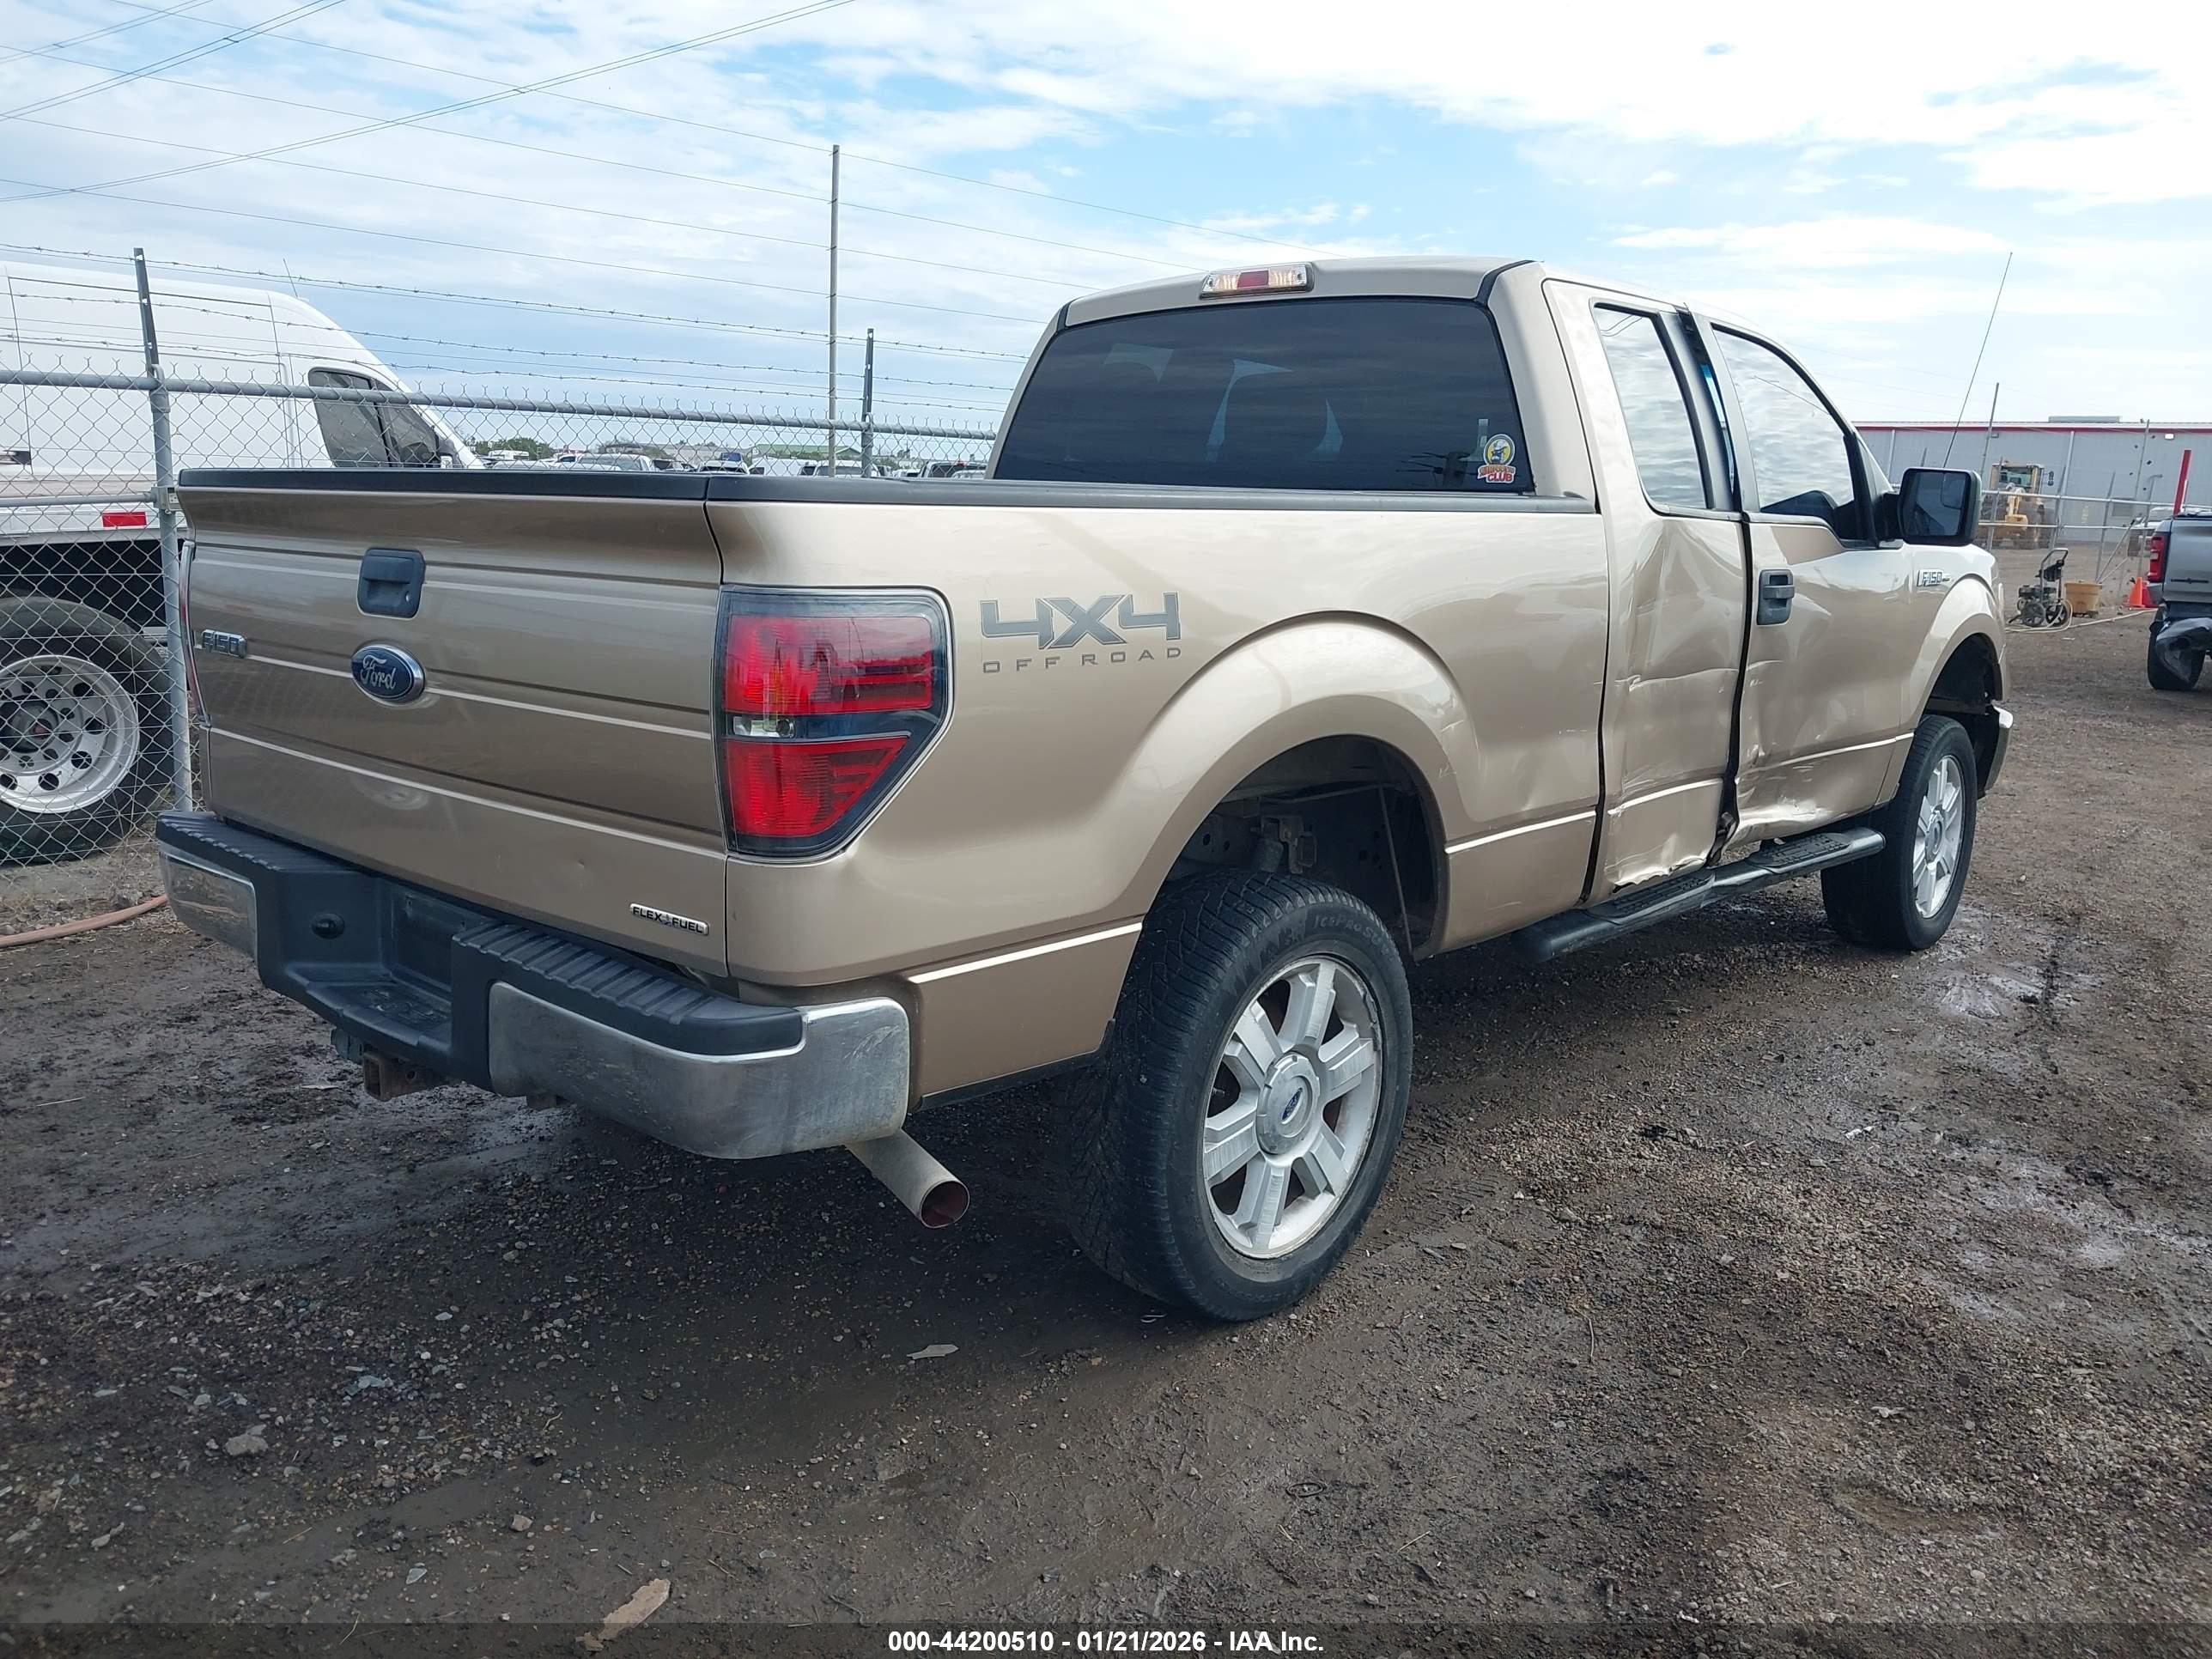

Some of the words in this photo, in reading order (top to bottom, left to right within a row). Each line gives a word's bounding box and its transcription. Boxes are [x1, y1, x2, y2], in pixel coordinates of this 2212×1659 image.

[980, 592, 1182, 649] 4X4
[361, 654, 397, 690] Ford
[982, 656, 1060, 673] OFF
[1081, 647, 1182, 666] ROAD
[633, 906, 663, 923] FLEX
[672, 917, 703, 933] FUEL
